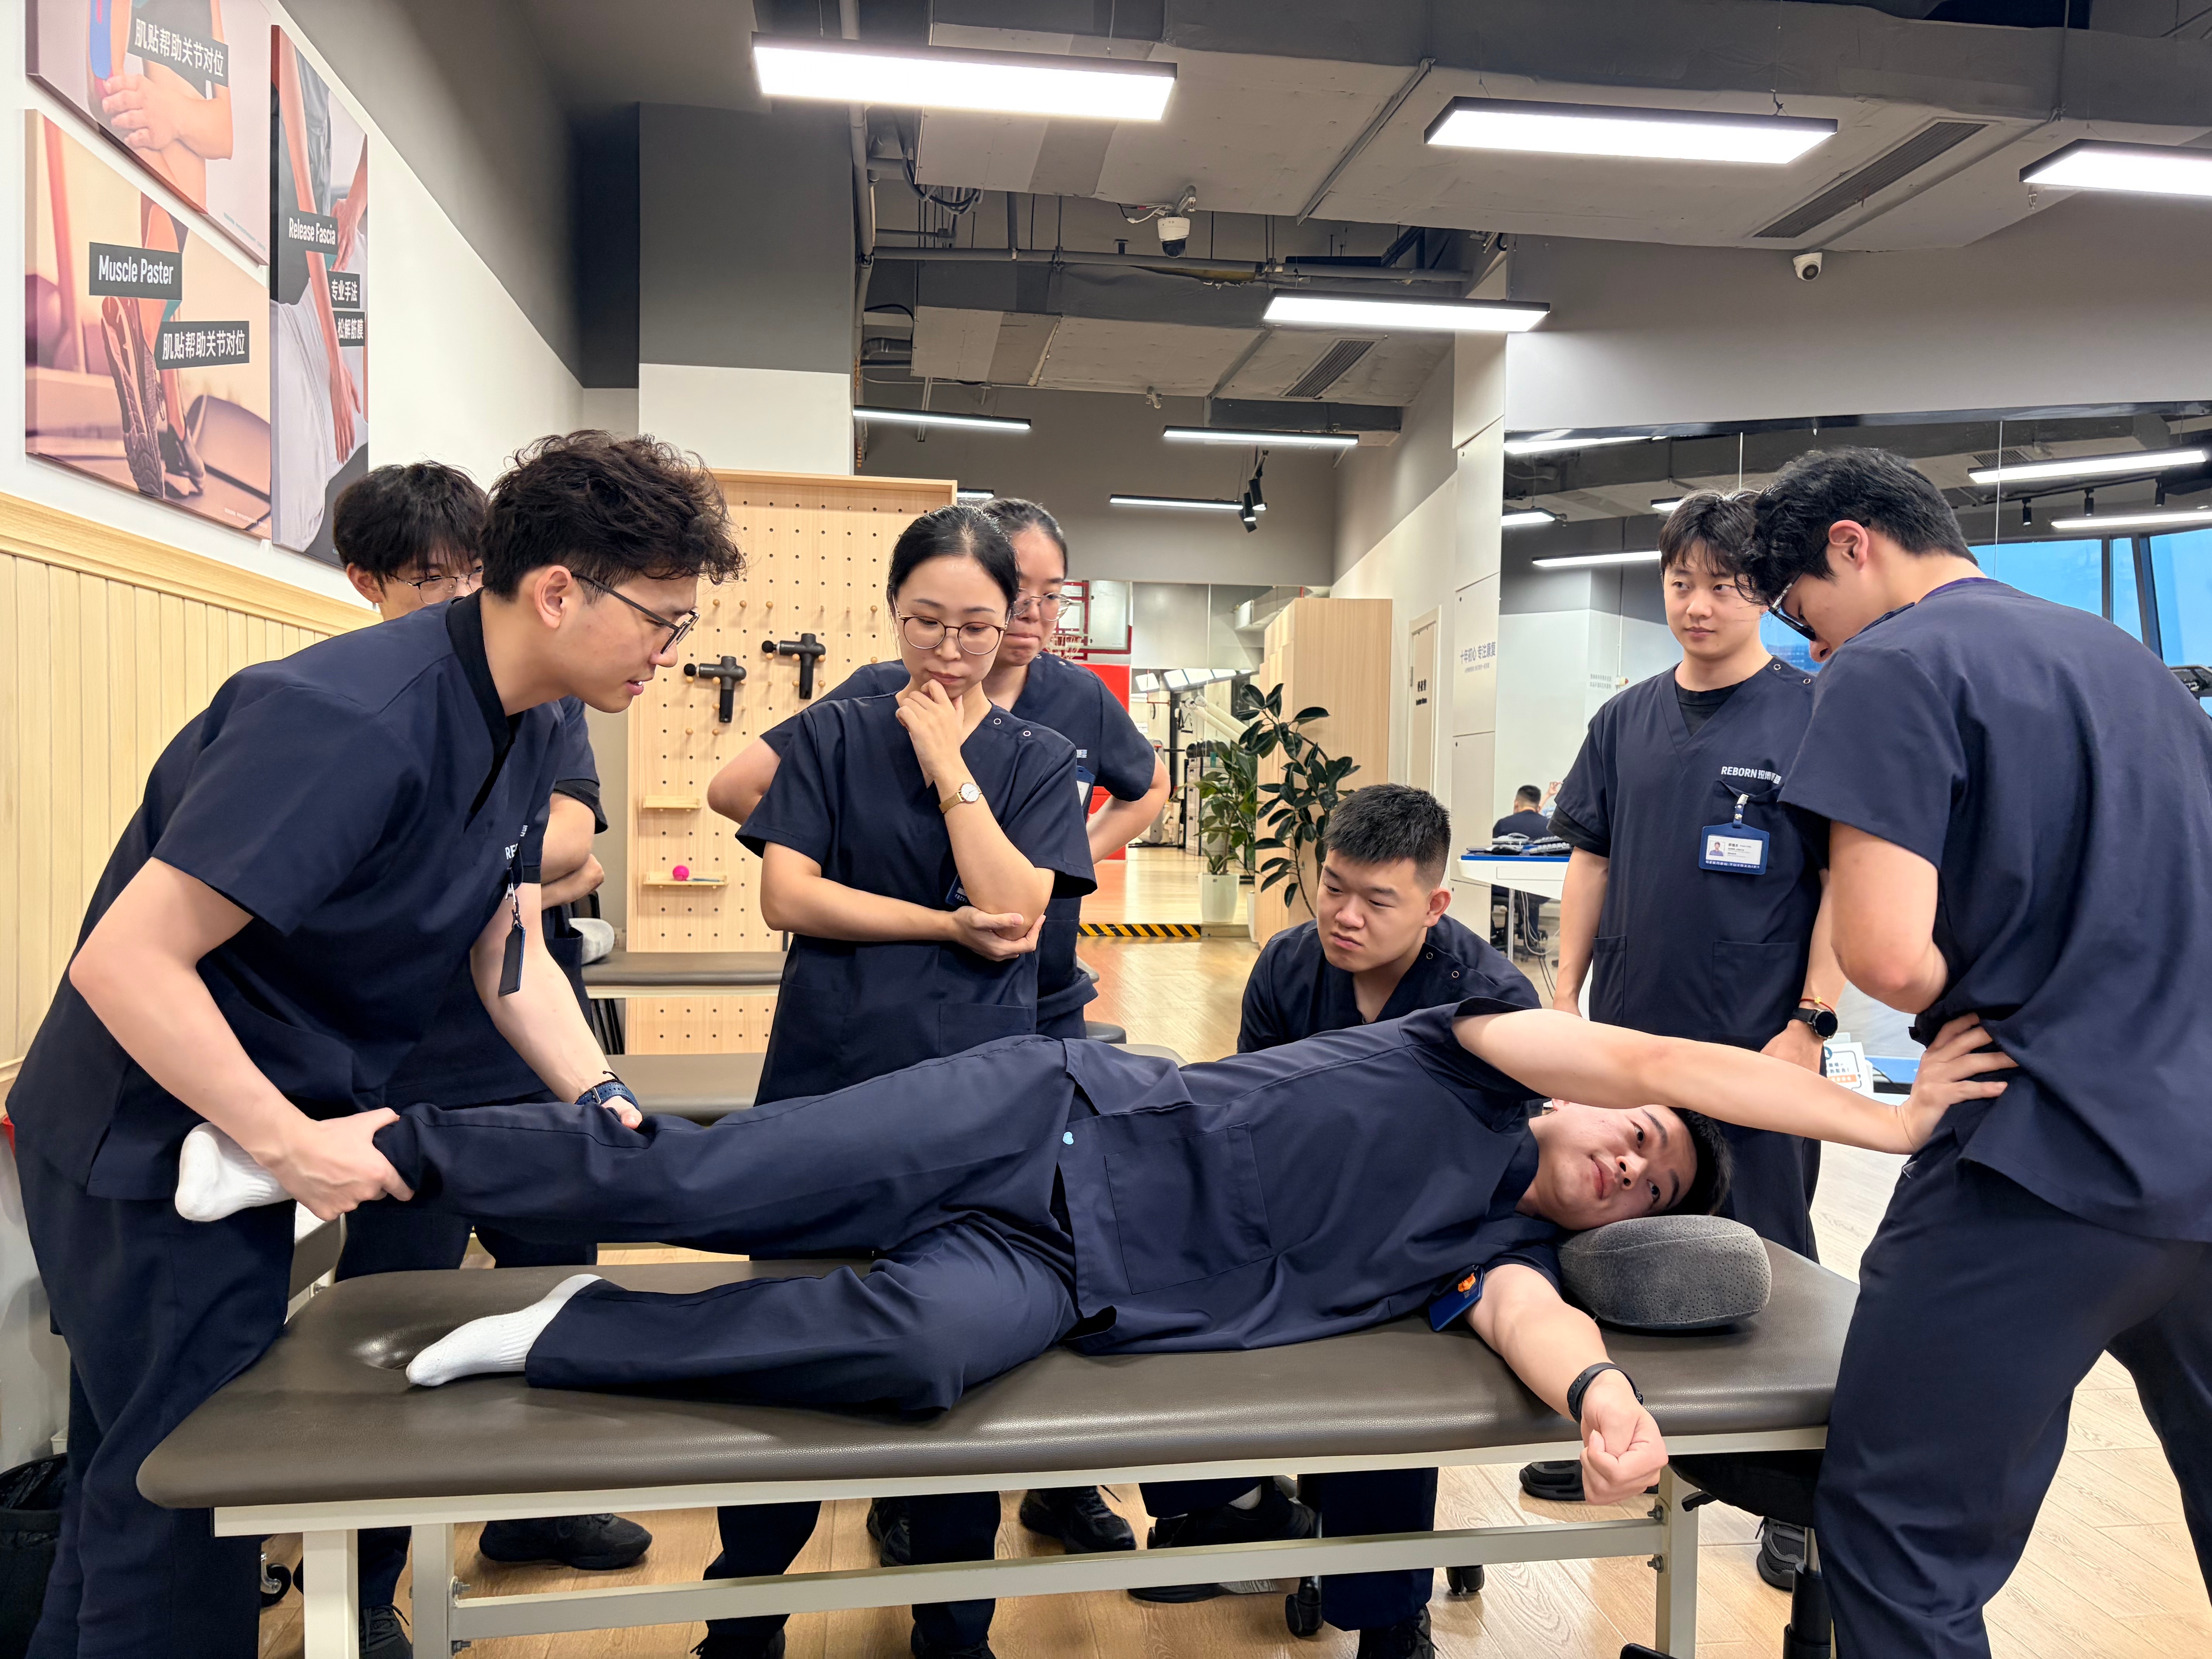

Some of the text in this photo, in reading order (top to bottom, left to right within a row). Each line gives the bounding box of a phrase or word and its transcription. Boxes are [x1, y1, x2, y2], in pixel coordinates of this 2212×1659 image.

[134, 18, 224, 77] 肌贴帮助关节对位
[289, 217, 314, 242] Release
[316, 222, 335, 245] Fascia
[98, 255, 173, 285] Muscle Paster
[331, 279, 357, 302] 专业手法
[338, 318, 364, 340] 松解筋膜
[162, 330, 245, 360] 肌贴帮助关节对位
[1721, 766, 1757, 778] REBORN
